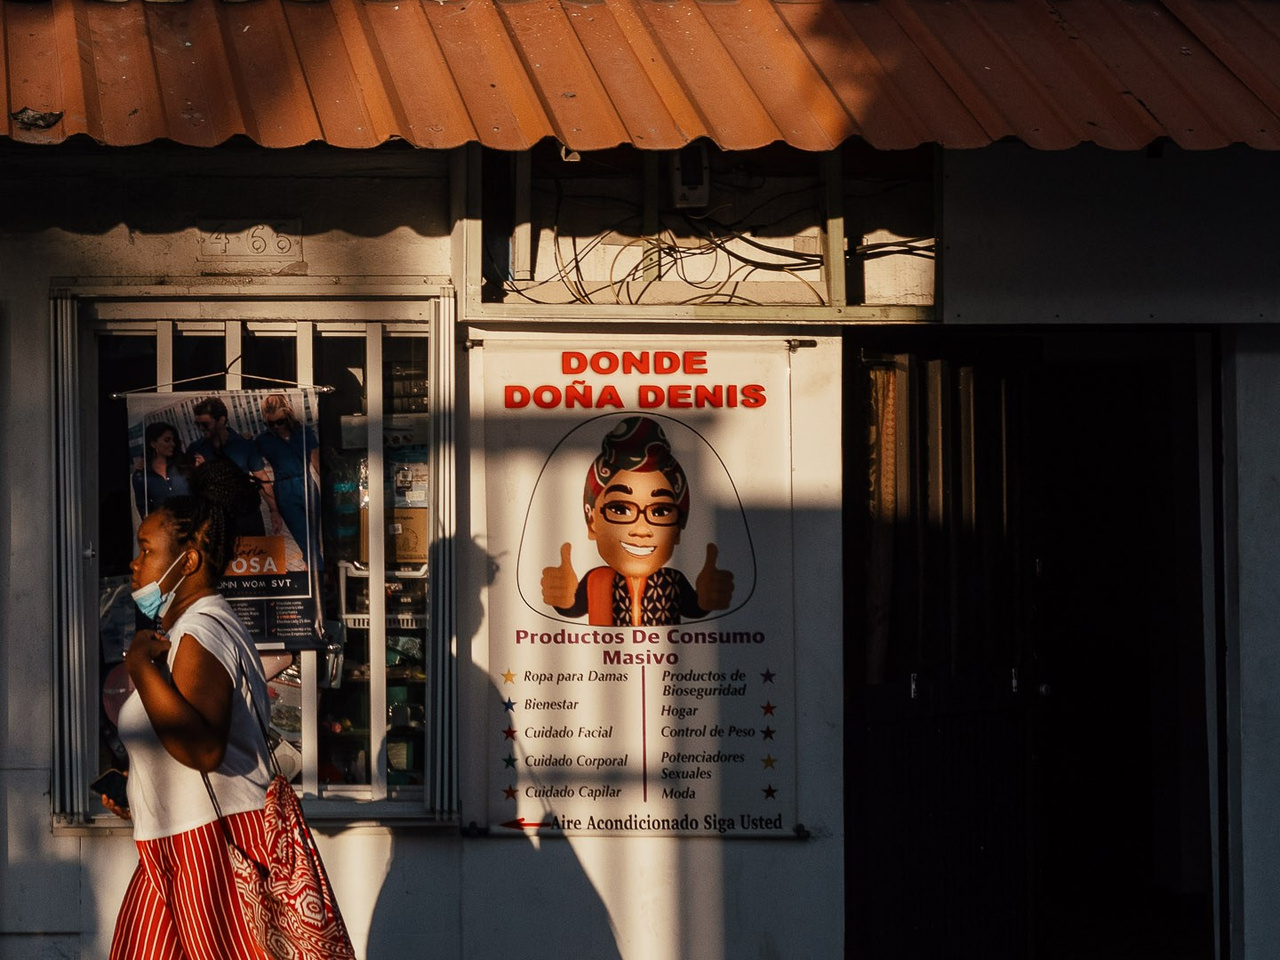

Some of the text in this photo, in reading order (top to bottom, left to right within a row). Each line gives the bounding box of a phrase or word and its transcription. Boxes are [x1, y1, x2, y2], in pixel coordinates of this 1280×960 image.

[562, 351, 707, 374] DONDE
[503, 380, 766, 409] DOÑA DENIS
[271, 579, 291, 587] SVT
[516, 629, 765, 644] Productos De Consumo
[603, 650, 678, 665] Masivo
[524, 671, 628, 685] Ropa para Damas
[662, 669, 746, 681] Productos de
[663, 684, 747, 699] Bioseguridad
[525, 699, 578, 710] Bienestar
[661, 705, 698, 719] Hogar
[525, 726, 613, 738] Cuidado Facial
[661, 725, 755, 737] Control de Peso
[525, 754, 628, 770] Cuidado Corporal
[661, 751, 744, 763] Potenciadores
[661, 767, 711, 779] Sexuales
[526, 785, 621, 801] Cuidado Capilar
[662, 787, 695, 799] Moda
[551, 813, 782, 833] Aire Acondicionado Siga Usted
